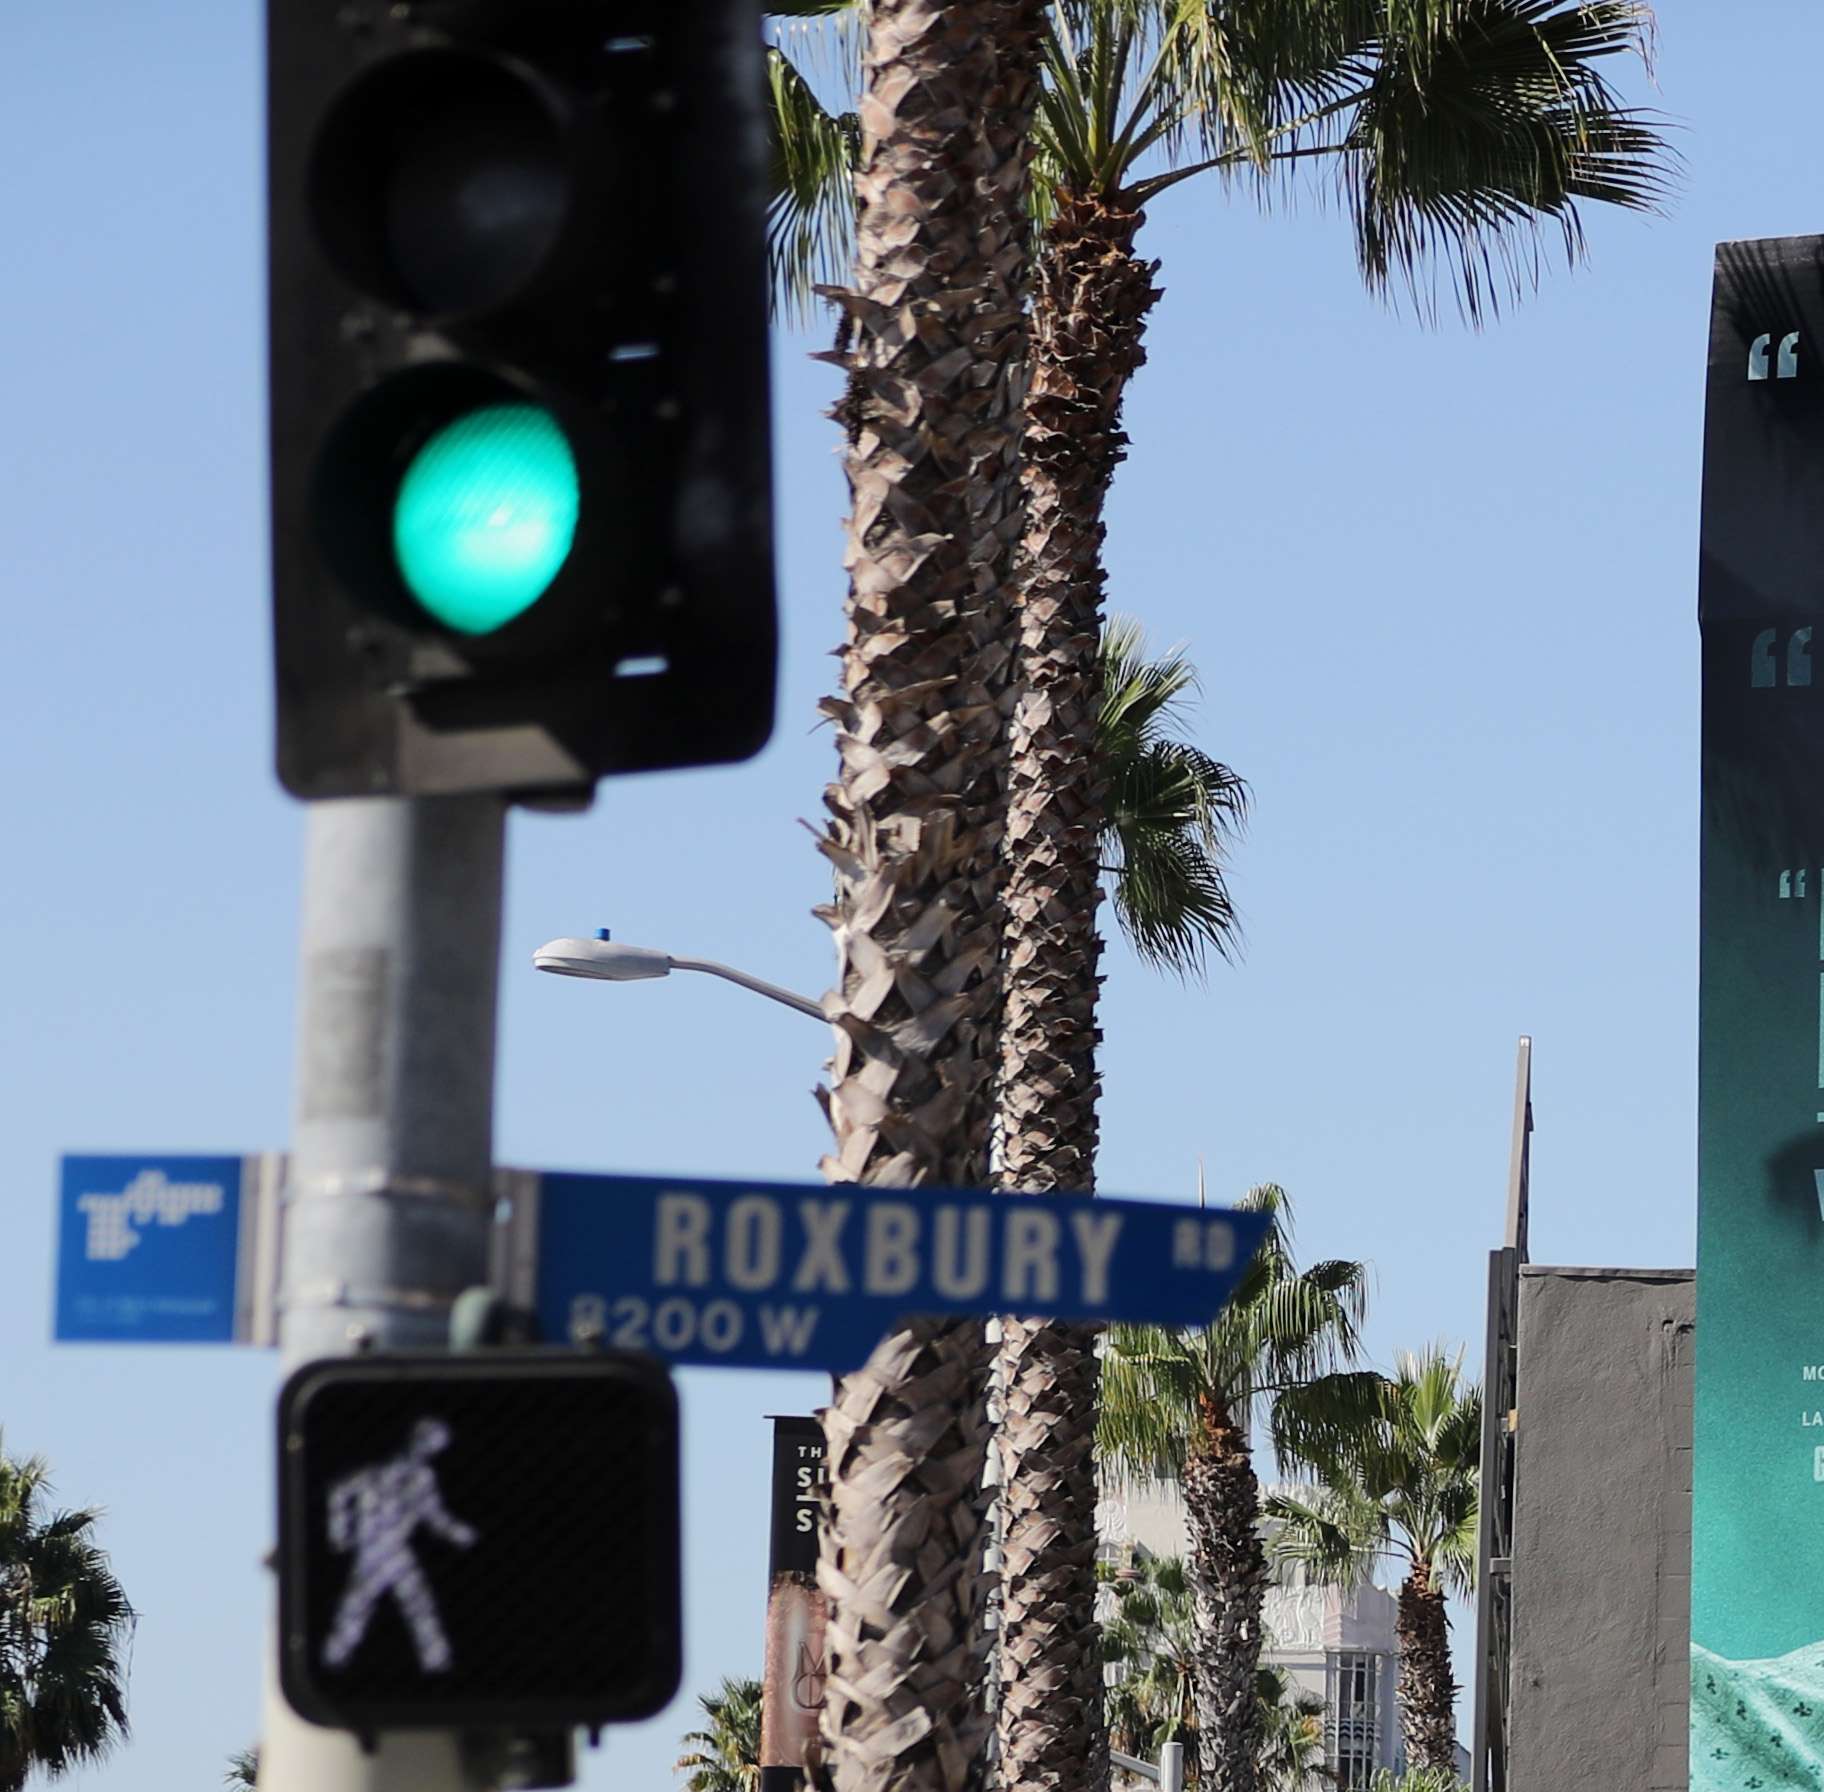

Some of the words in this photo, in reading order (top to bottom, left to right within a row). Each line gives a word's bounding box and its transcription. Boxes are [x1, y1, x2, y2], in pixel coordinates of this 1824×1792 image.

[653, 1191, 1124, 1305] ROXBURY
[1171, 1219, 1236, 1272] RD
[757, 1304, 821, 1356] W
[1802, 1412, 1824, 1427] LA
[797, 1446, 822, 1458] TH
